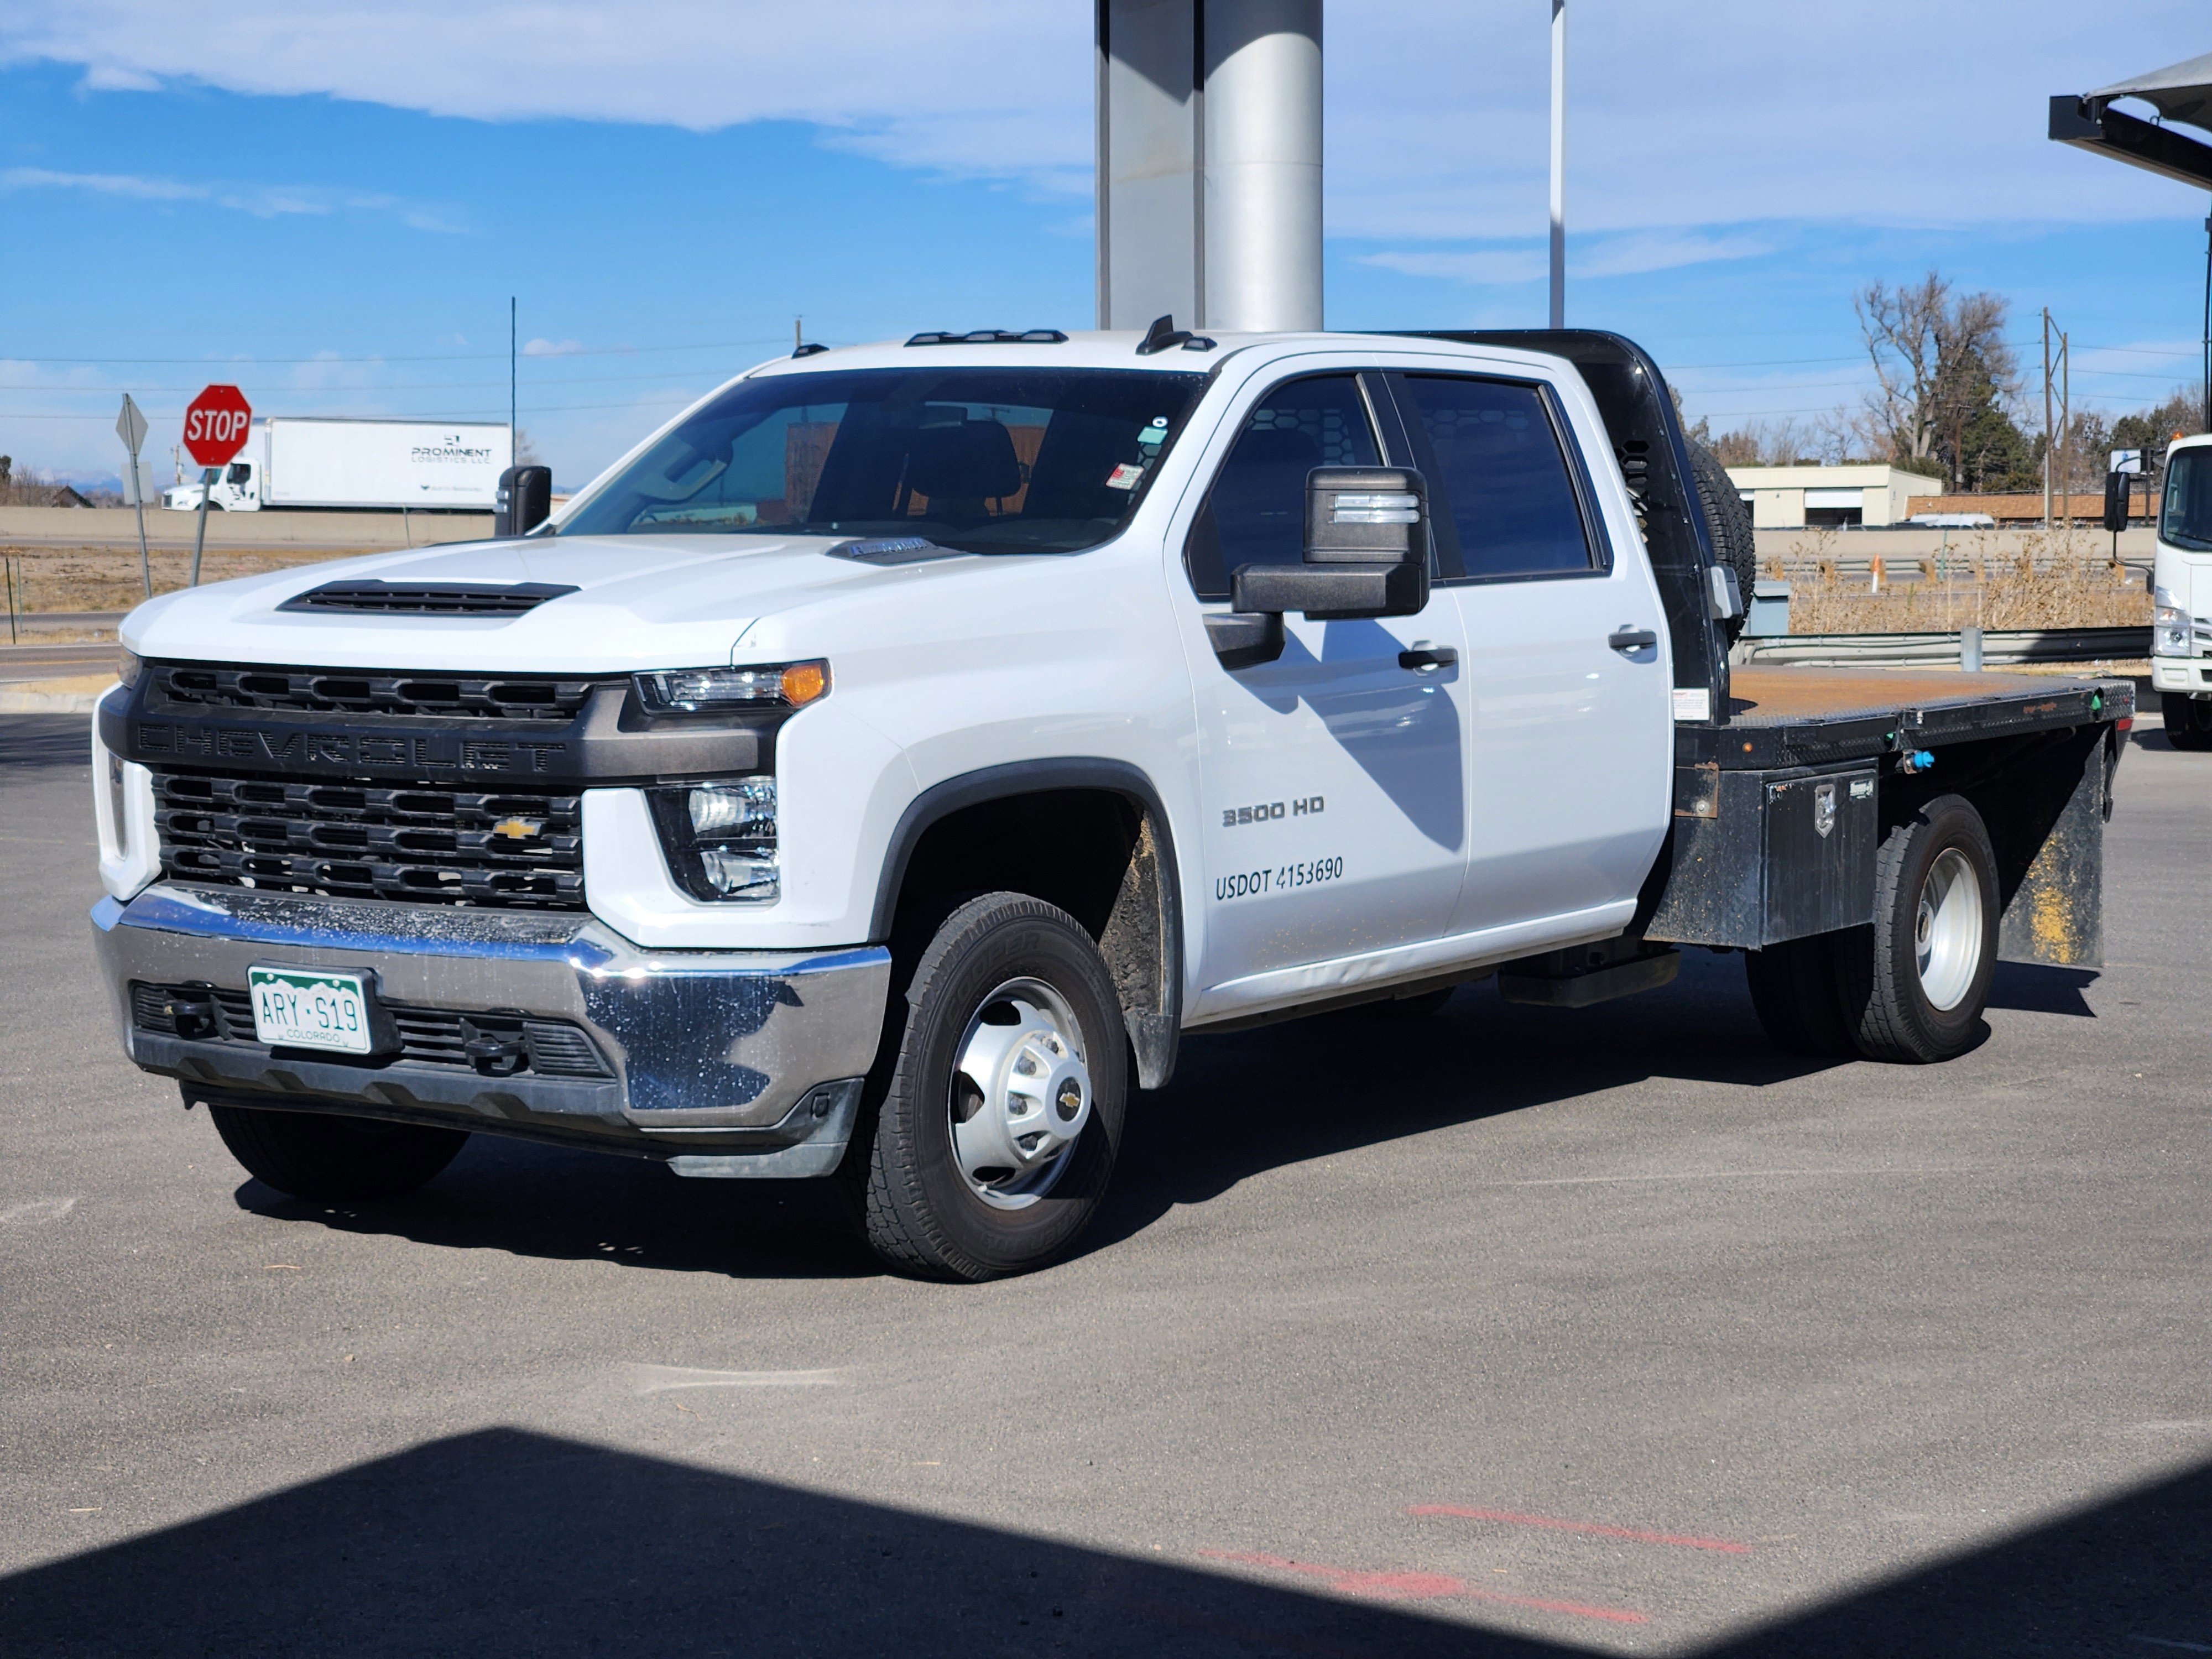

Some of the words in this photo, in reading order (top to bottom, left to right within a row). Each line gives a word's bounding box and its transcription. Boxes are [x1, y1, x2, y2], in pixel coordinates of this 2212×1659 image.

[187, 410, 248, 442] STOP
[412, 447, 492, 457] PROMINENT
[138, 722, 566, 773] CHEVROLET
[1222, 802, 1285, 828] 3500
[1292, 796, 1324, 816] HD
[1216, 869, 1272, 901] USDOT
[1276, 856, 1343, 889] 4153690
[287, 1028, 340, 1042] COLORADO
